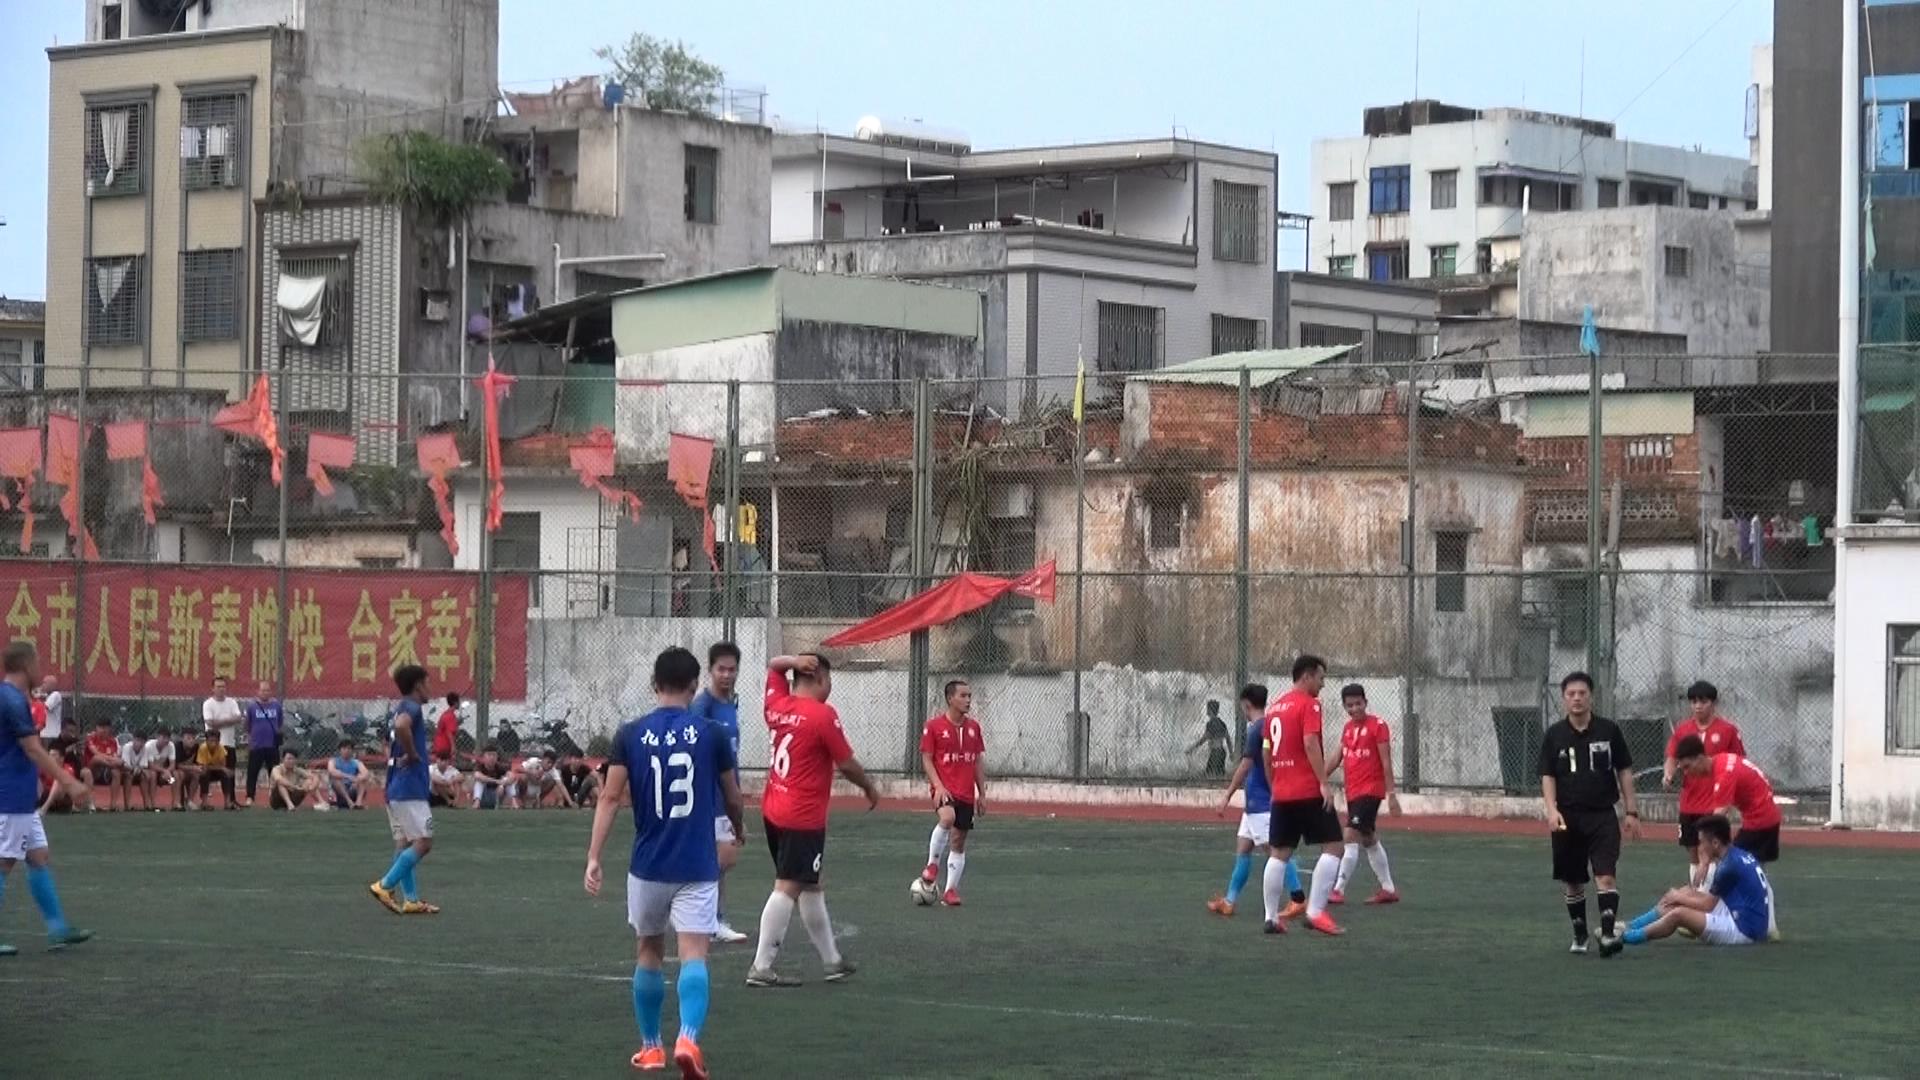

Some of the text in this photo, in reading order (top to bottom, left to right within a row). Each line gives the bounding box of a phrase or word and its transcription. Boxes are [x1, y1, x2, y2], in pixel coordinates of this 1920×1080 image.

[6, 579, 324, 682] 全市人民新春愉快
[1269, 716, 1283, 757] 9
[650, 751, 695, 819] 13
[812, 853, 822, 872] 6
